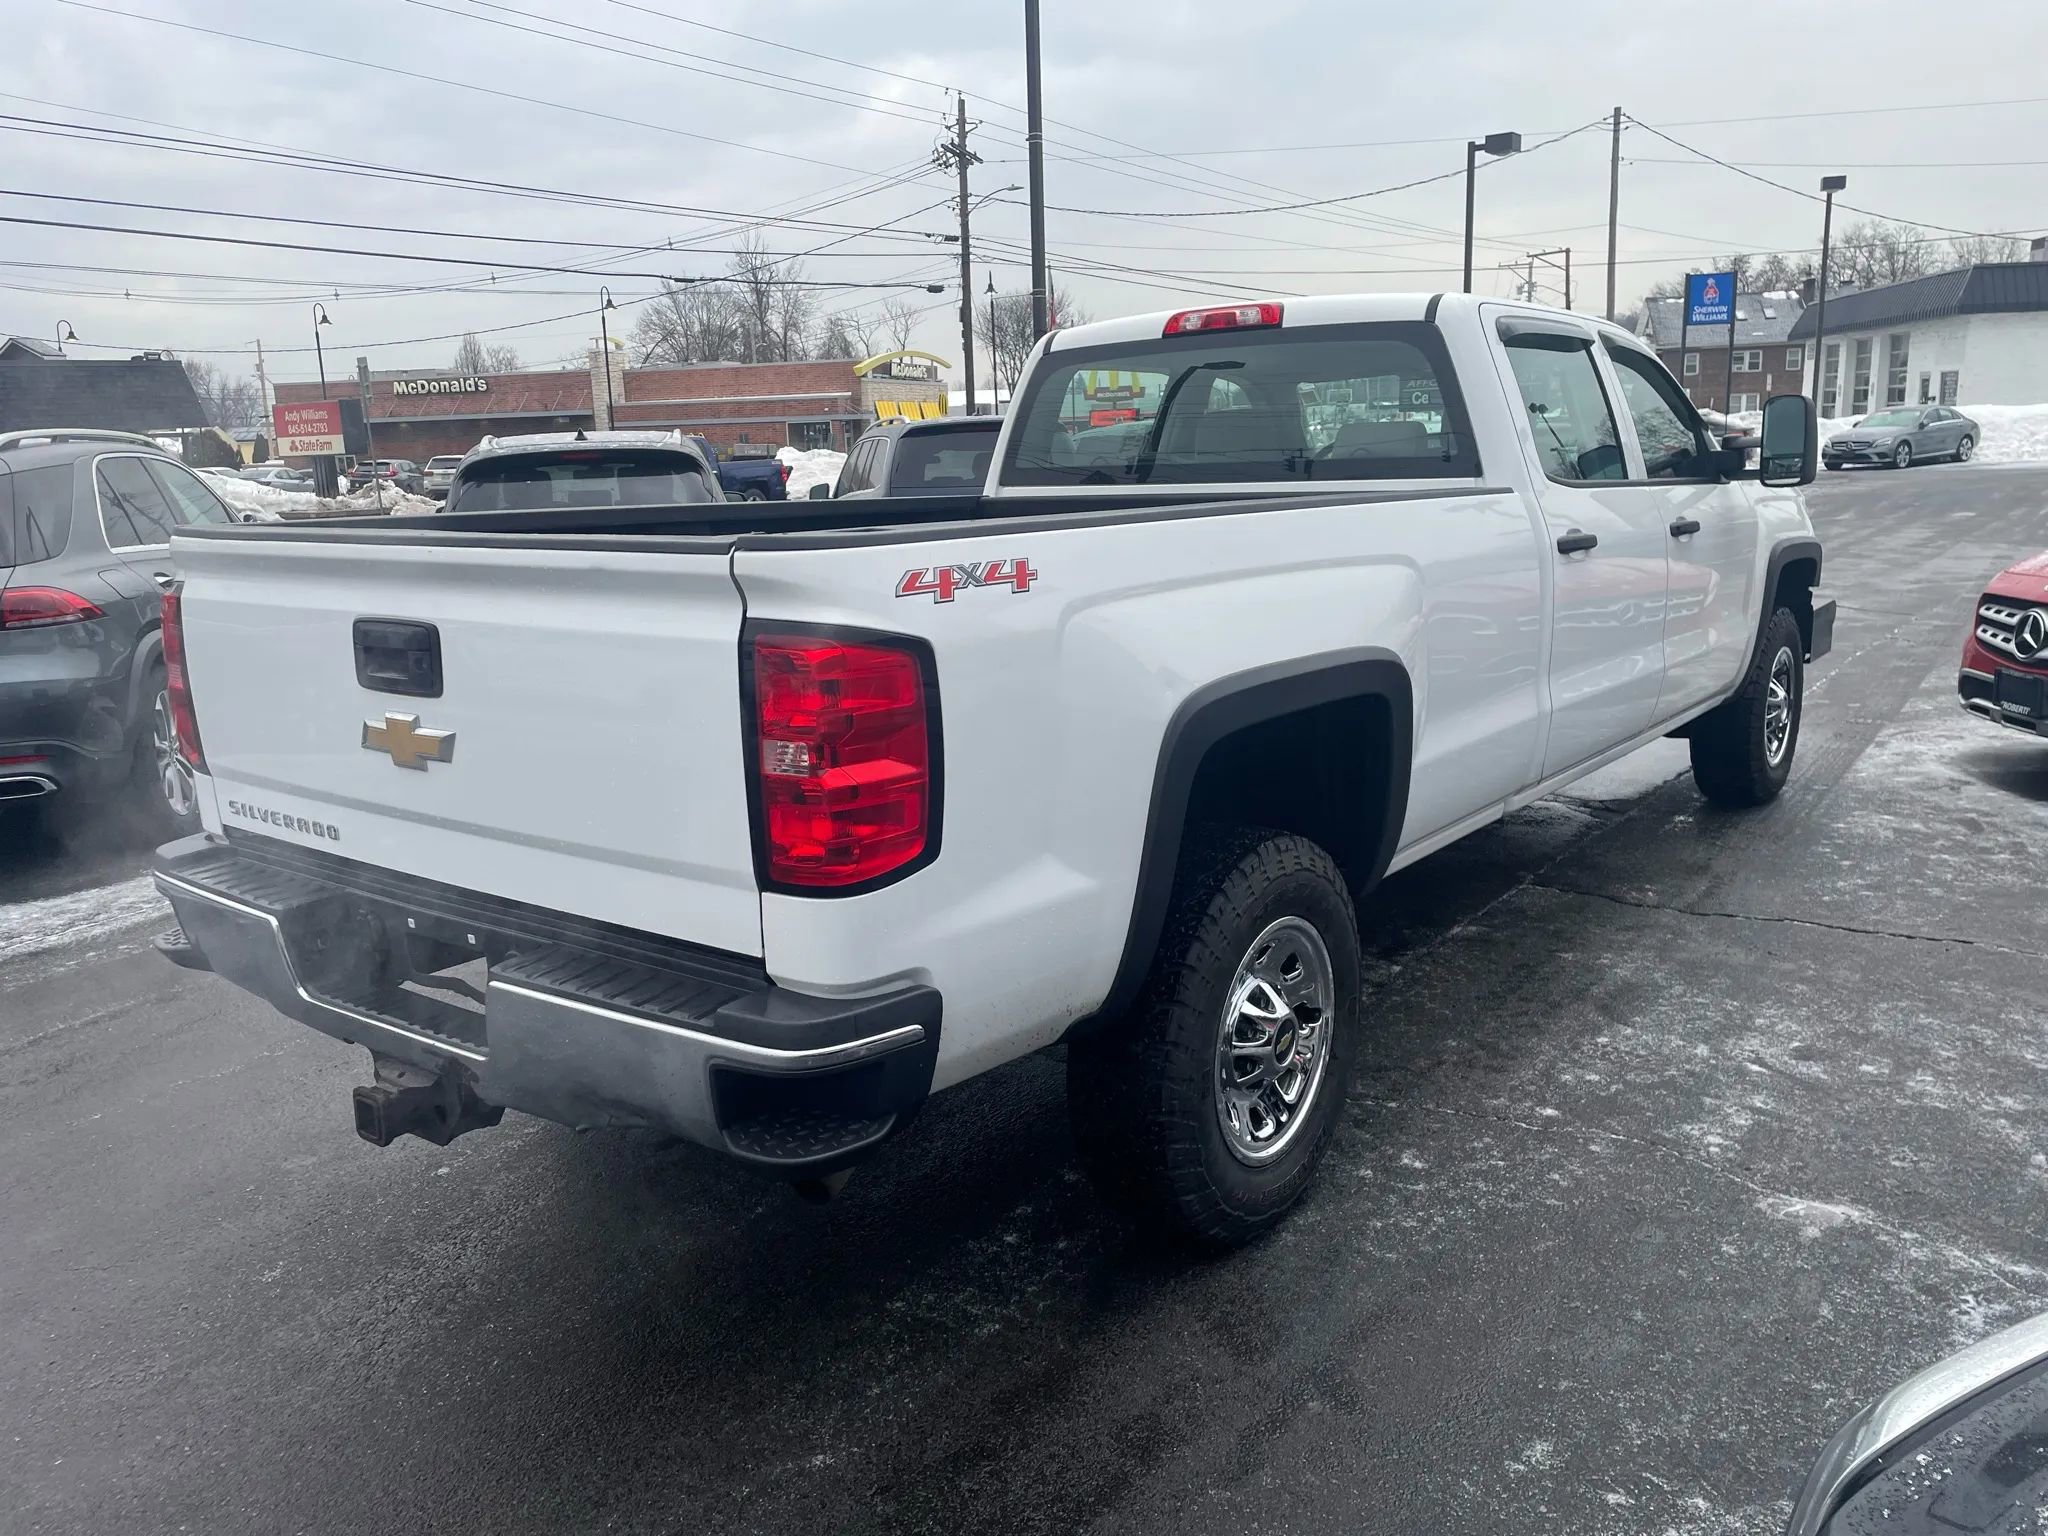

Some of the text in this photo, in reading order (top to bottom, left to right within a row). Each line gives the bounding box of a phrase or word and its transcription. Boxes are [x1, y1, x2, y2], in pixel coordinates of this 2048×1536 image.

[1692, 311, 1728, 322] WILLIAMS
[1693, 305, 1728, 314] SHERWIN
[393, 377, 487, 395] McDonald's
[285, 408, 328, 422] Andy Williams
[228, 799, 341, 842] SILVERADO
